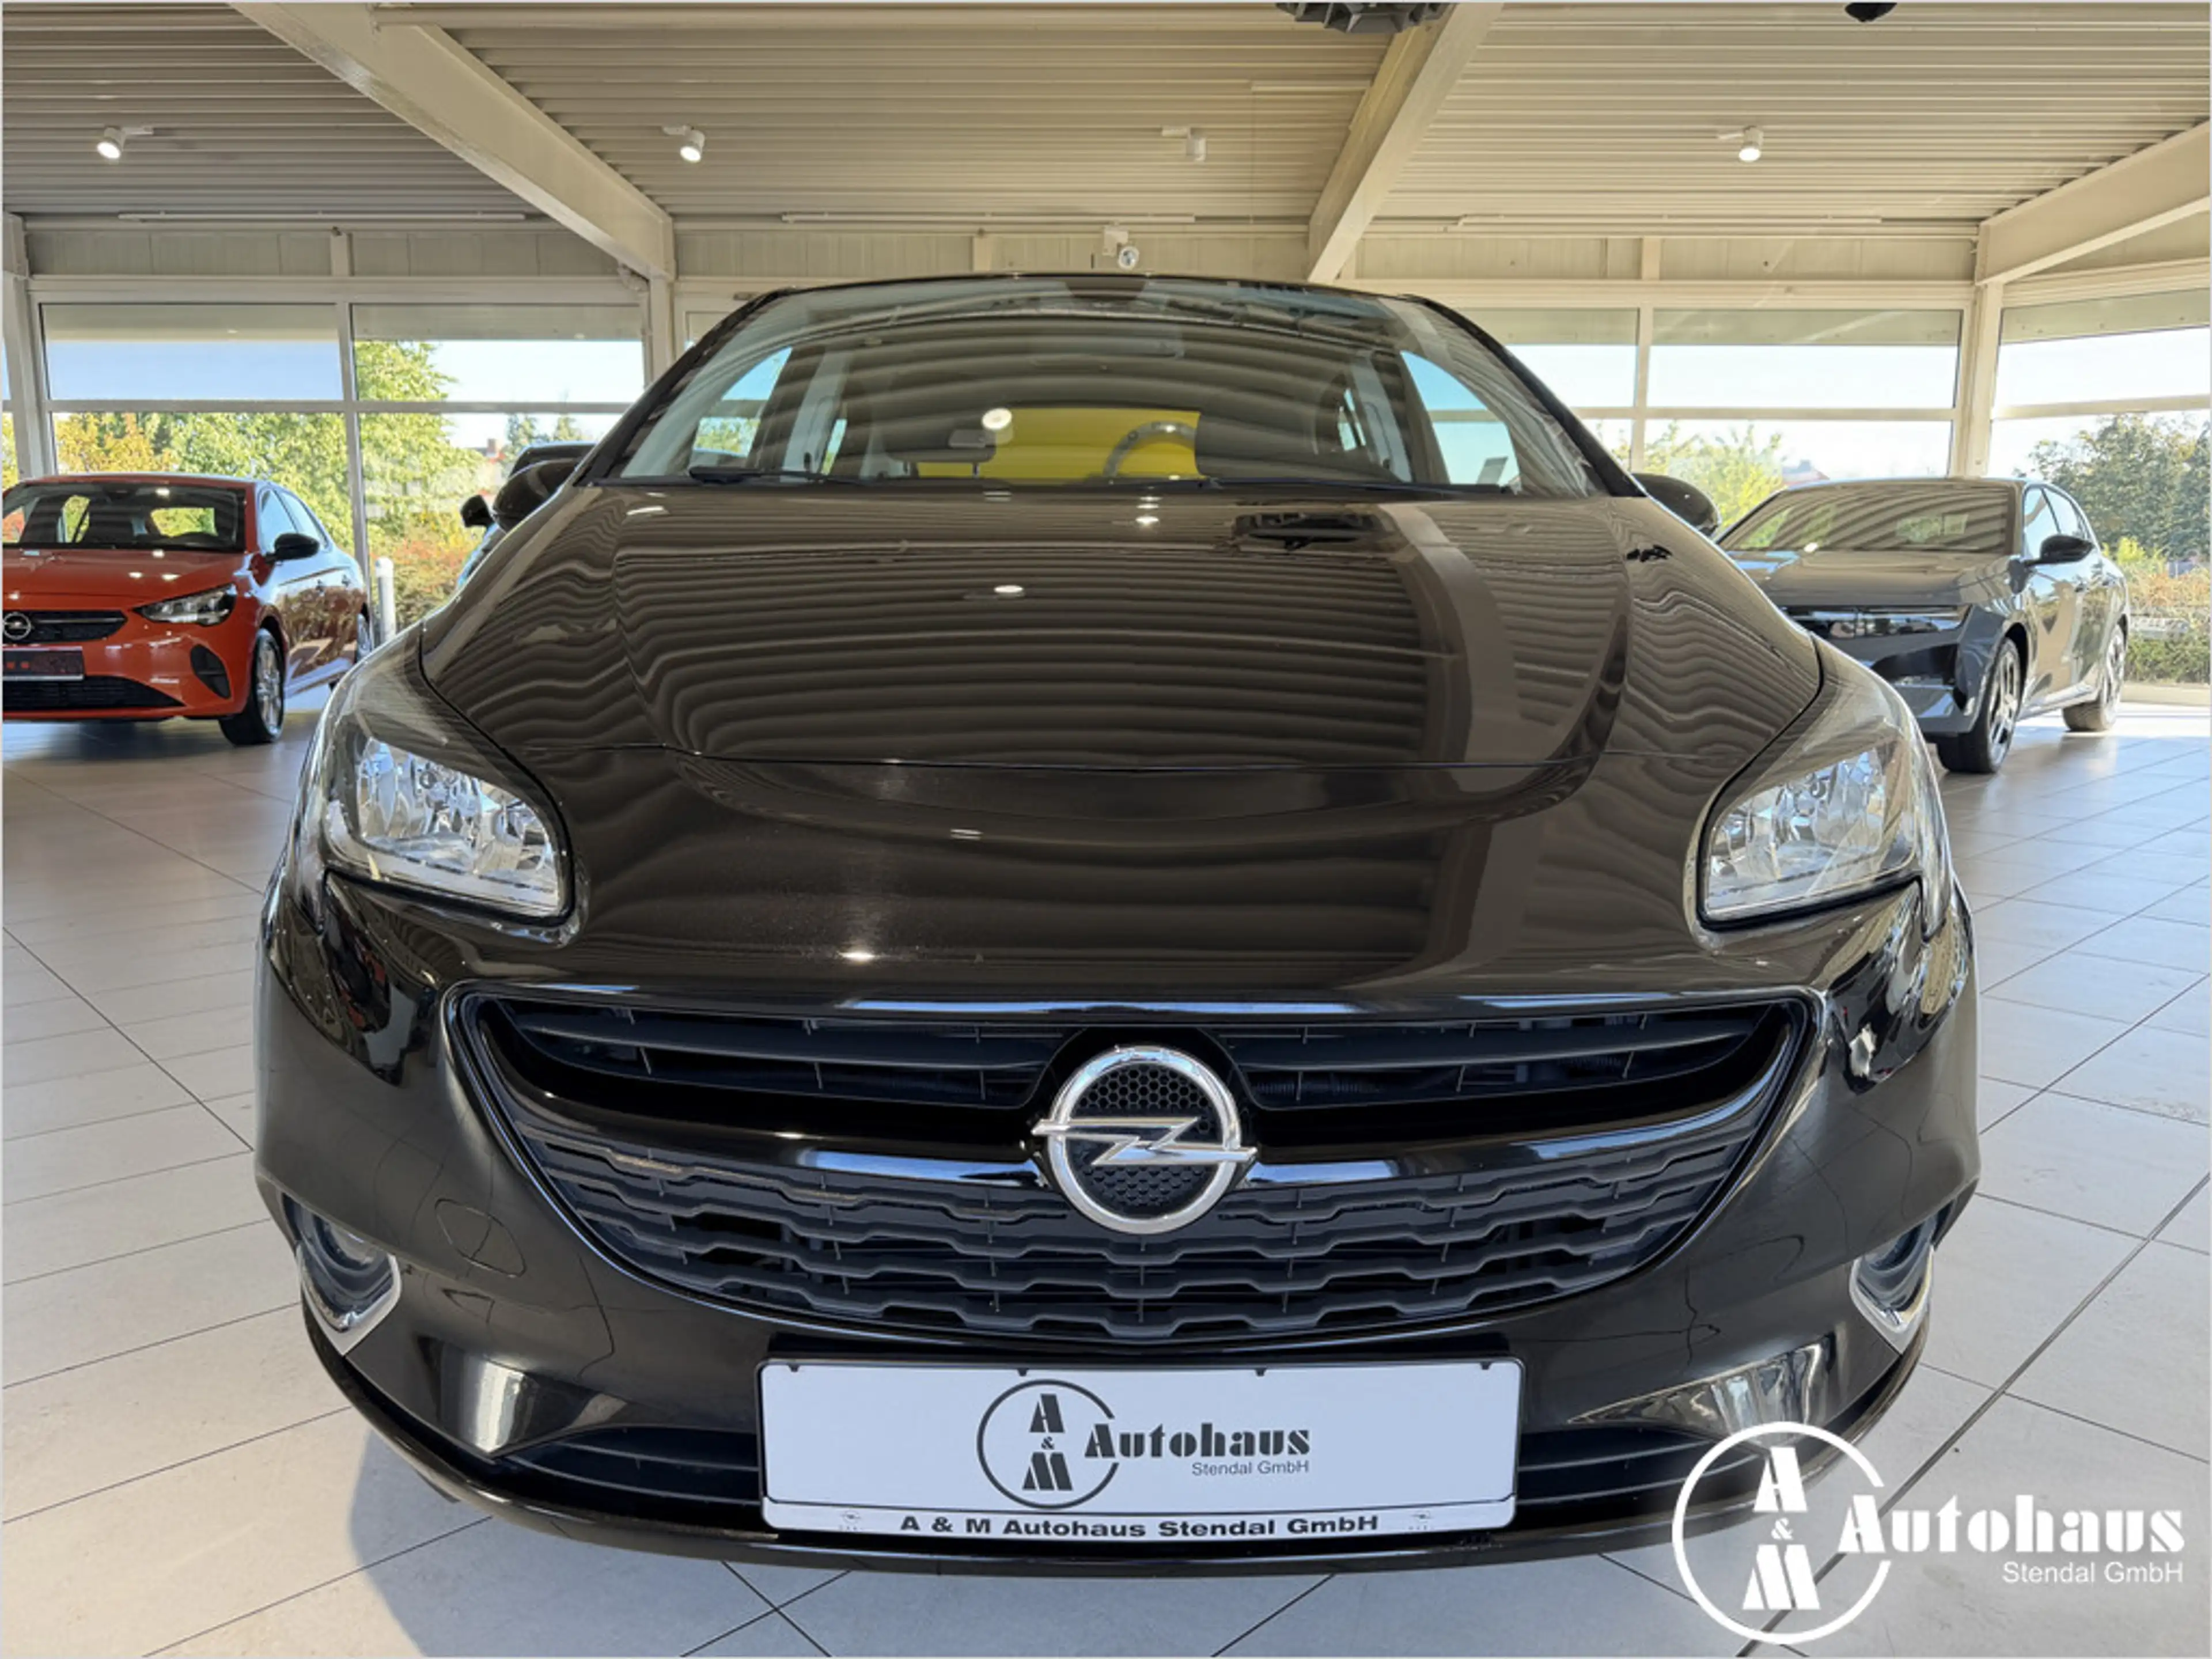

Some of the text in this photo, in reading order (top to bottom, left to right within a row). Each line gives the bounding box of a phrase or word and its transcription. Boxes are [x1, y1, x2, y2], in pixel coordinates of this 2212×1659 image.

[1029, 1393, 1065, 1433] A
[1040, 1435, 1055, 1450] &
[1084, 1422, 1310, 1458] Autohaus
[1022, 1452, 1073, 1491] M
[1191, 1459, 1310, 1476] Stendal GmbH
[900, 1515, 1378, 1537] A & M Autohaus Stendal GmbH
